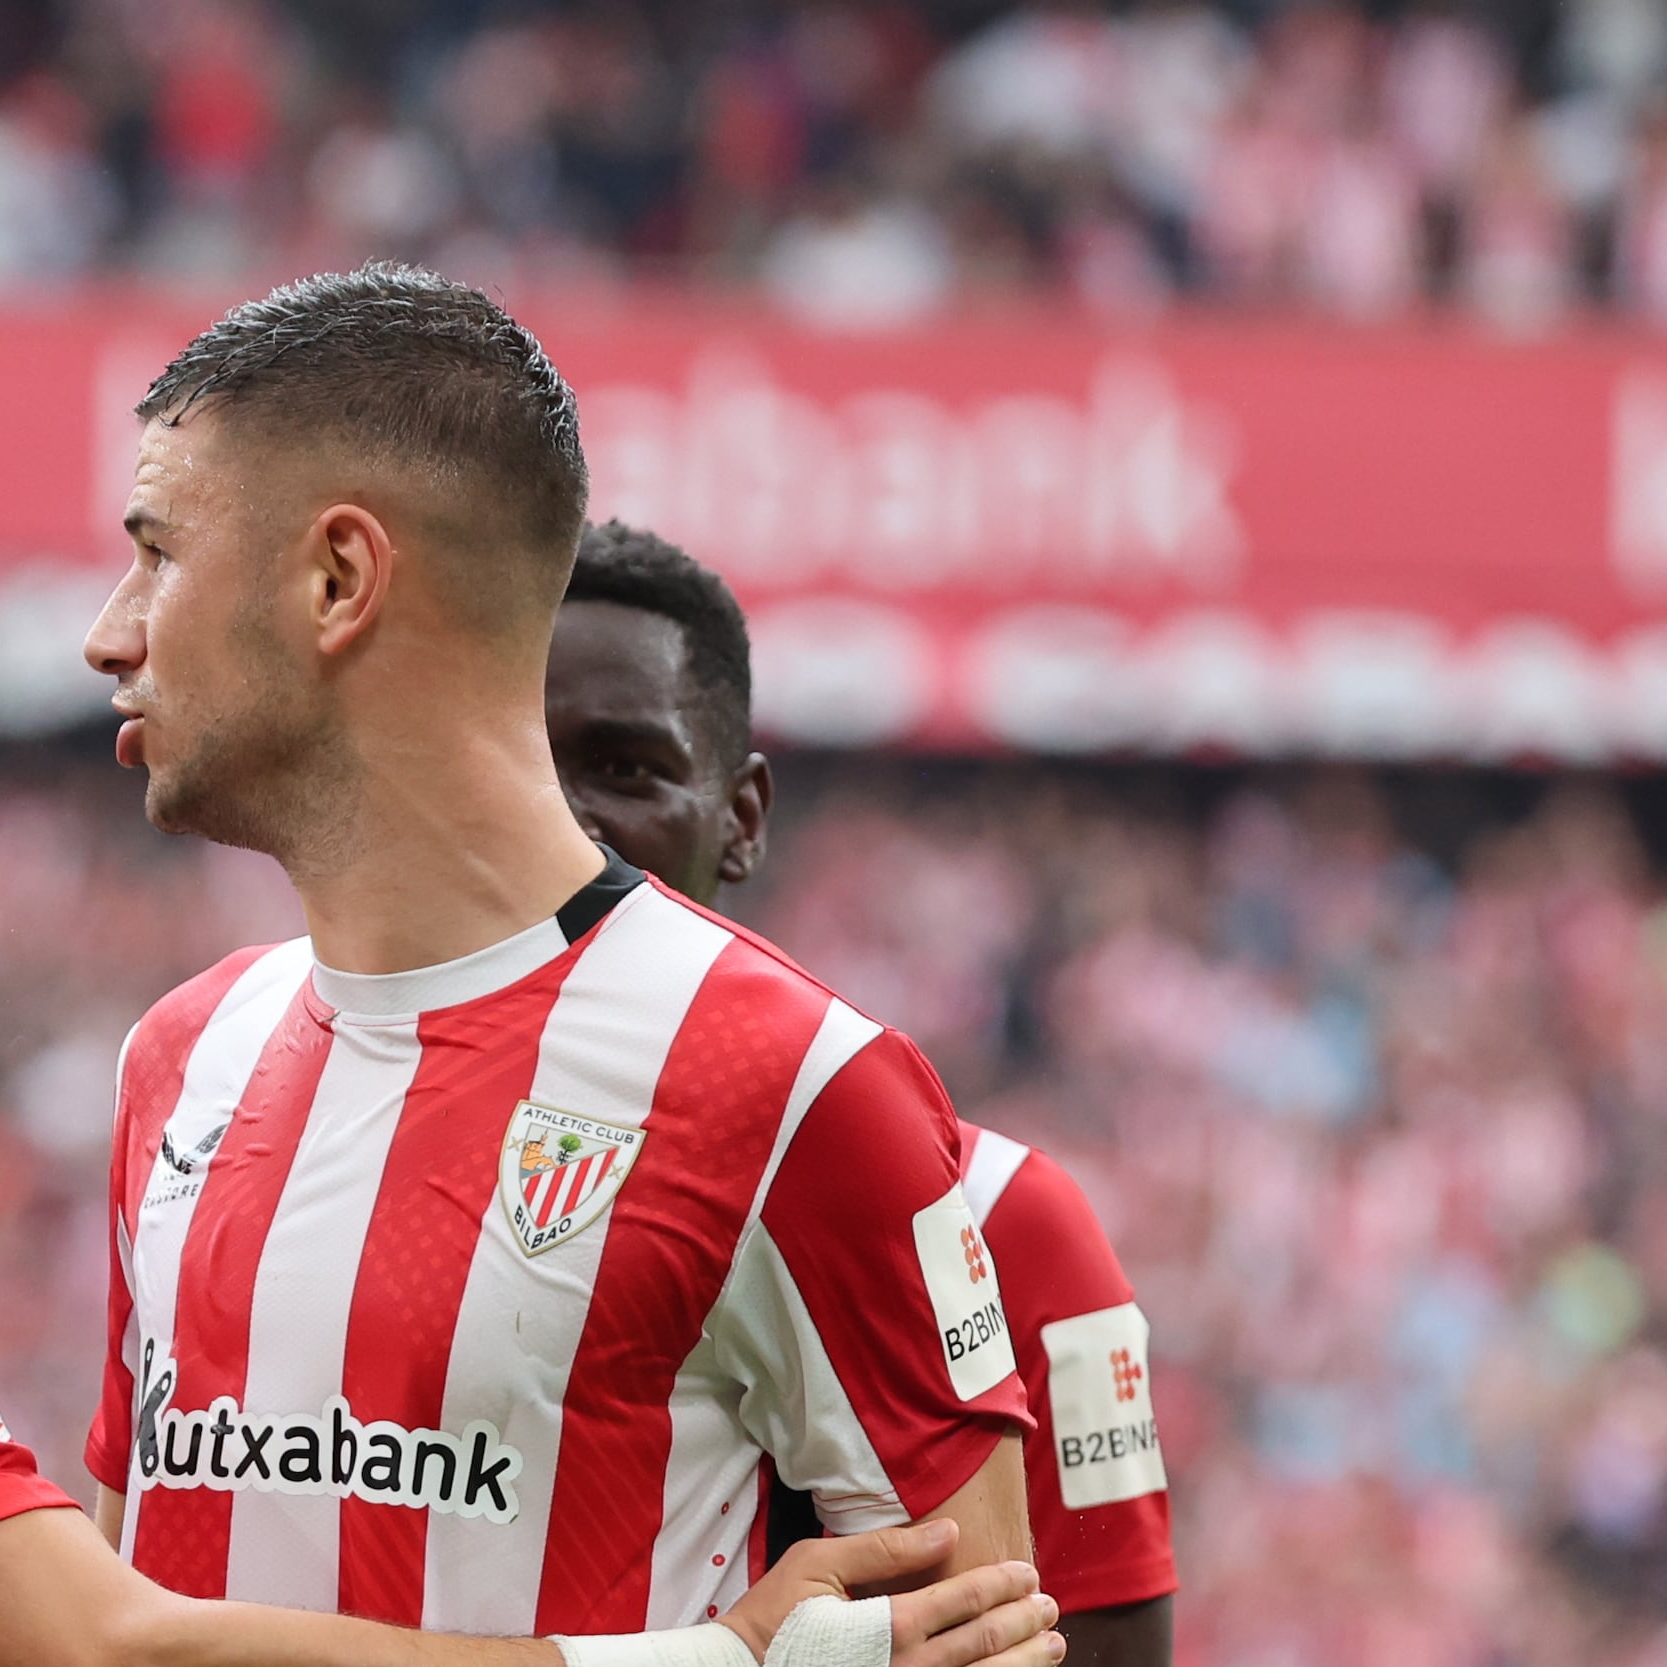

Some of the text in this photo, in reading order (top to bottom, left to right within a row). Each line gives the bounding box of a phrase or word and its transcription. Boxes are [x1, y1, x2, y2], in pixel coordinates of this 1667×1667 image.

[523, 1107, 635, 1145] ATHLETIC CLUB
[514, 1203, 572, 1250] BILBAO
